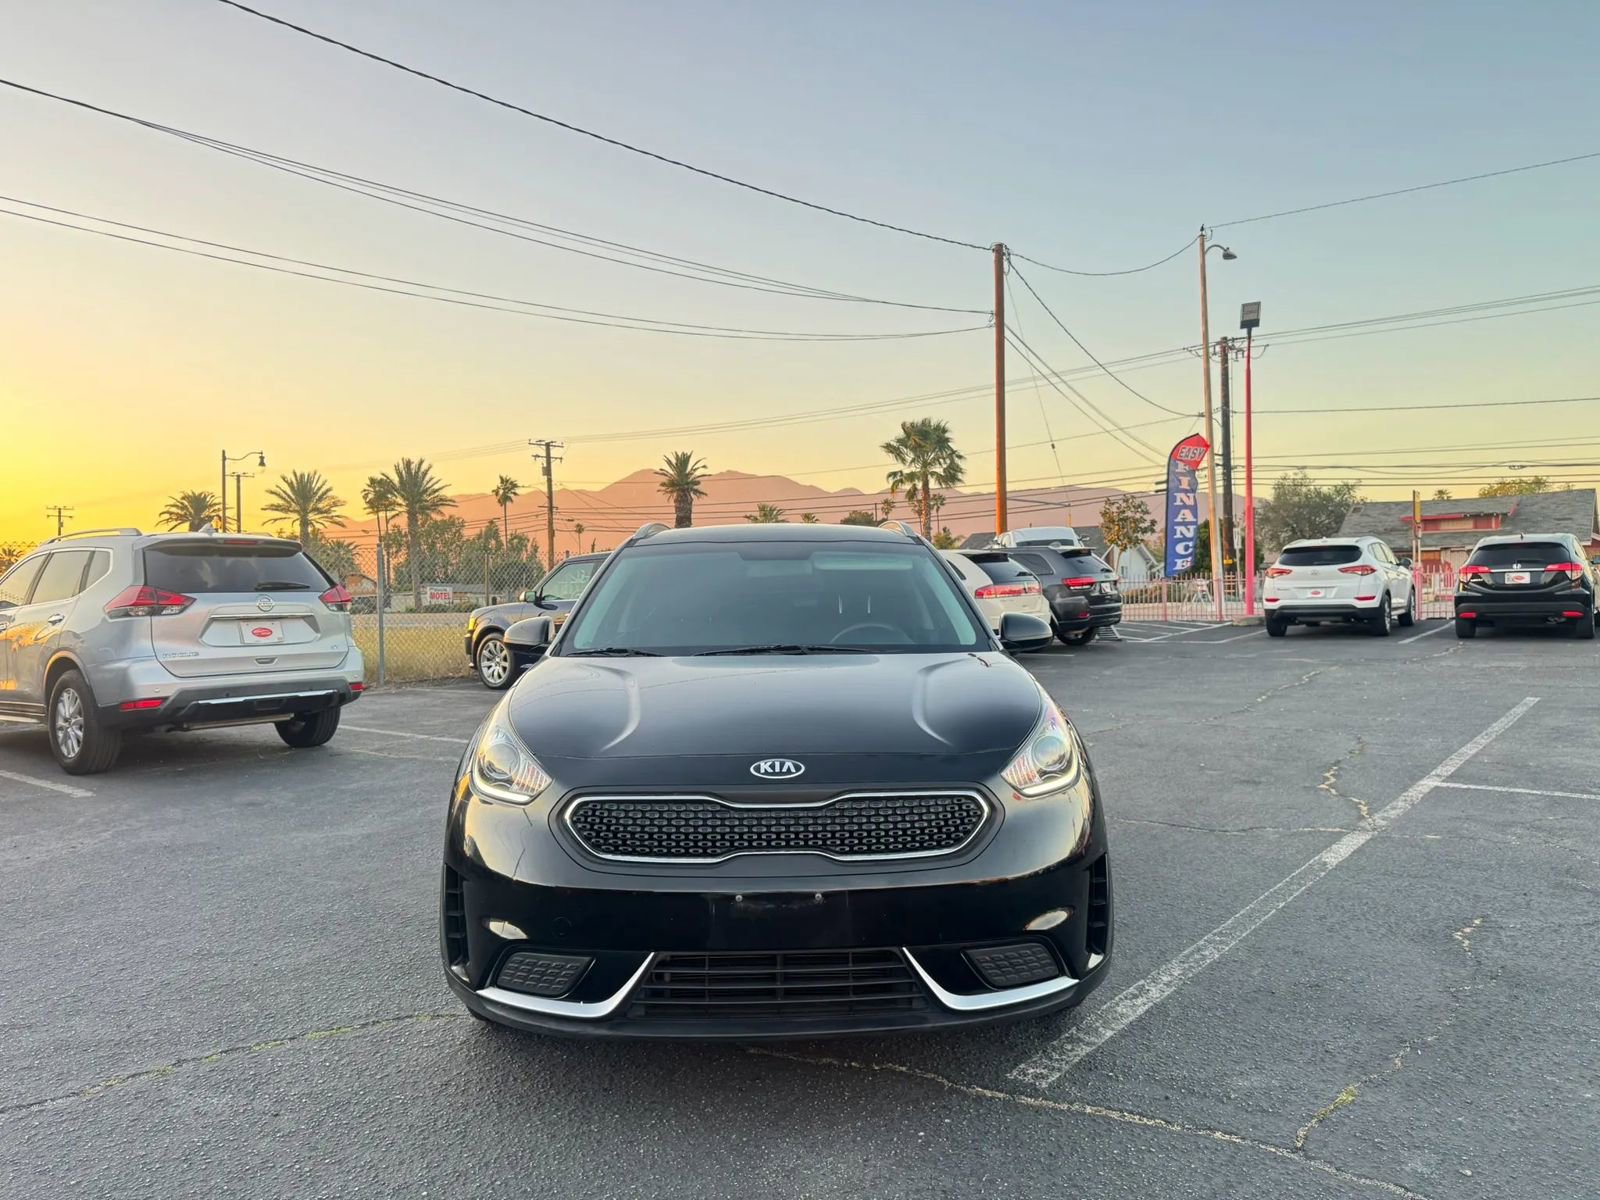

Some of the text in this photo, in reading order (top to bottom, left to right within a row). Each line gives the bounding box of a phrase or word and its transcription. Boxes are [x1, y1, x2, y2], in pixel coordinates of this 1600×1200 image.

[1179, 446, 1205, 460] EASY
[1173, 460, 1197, 570] FINANCE
[429, 591, 450, 600] MOTEL
[760, 761, 796, 773] KIA
